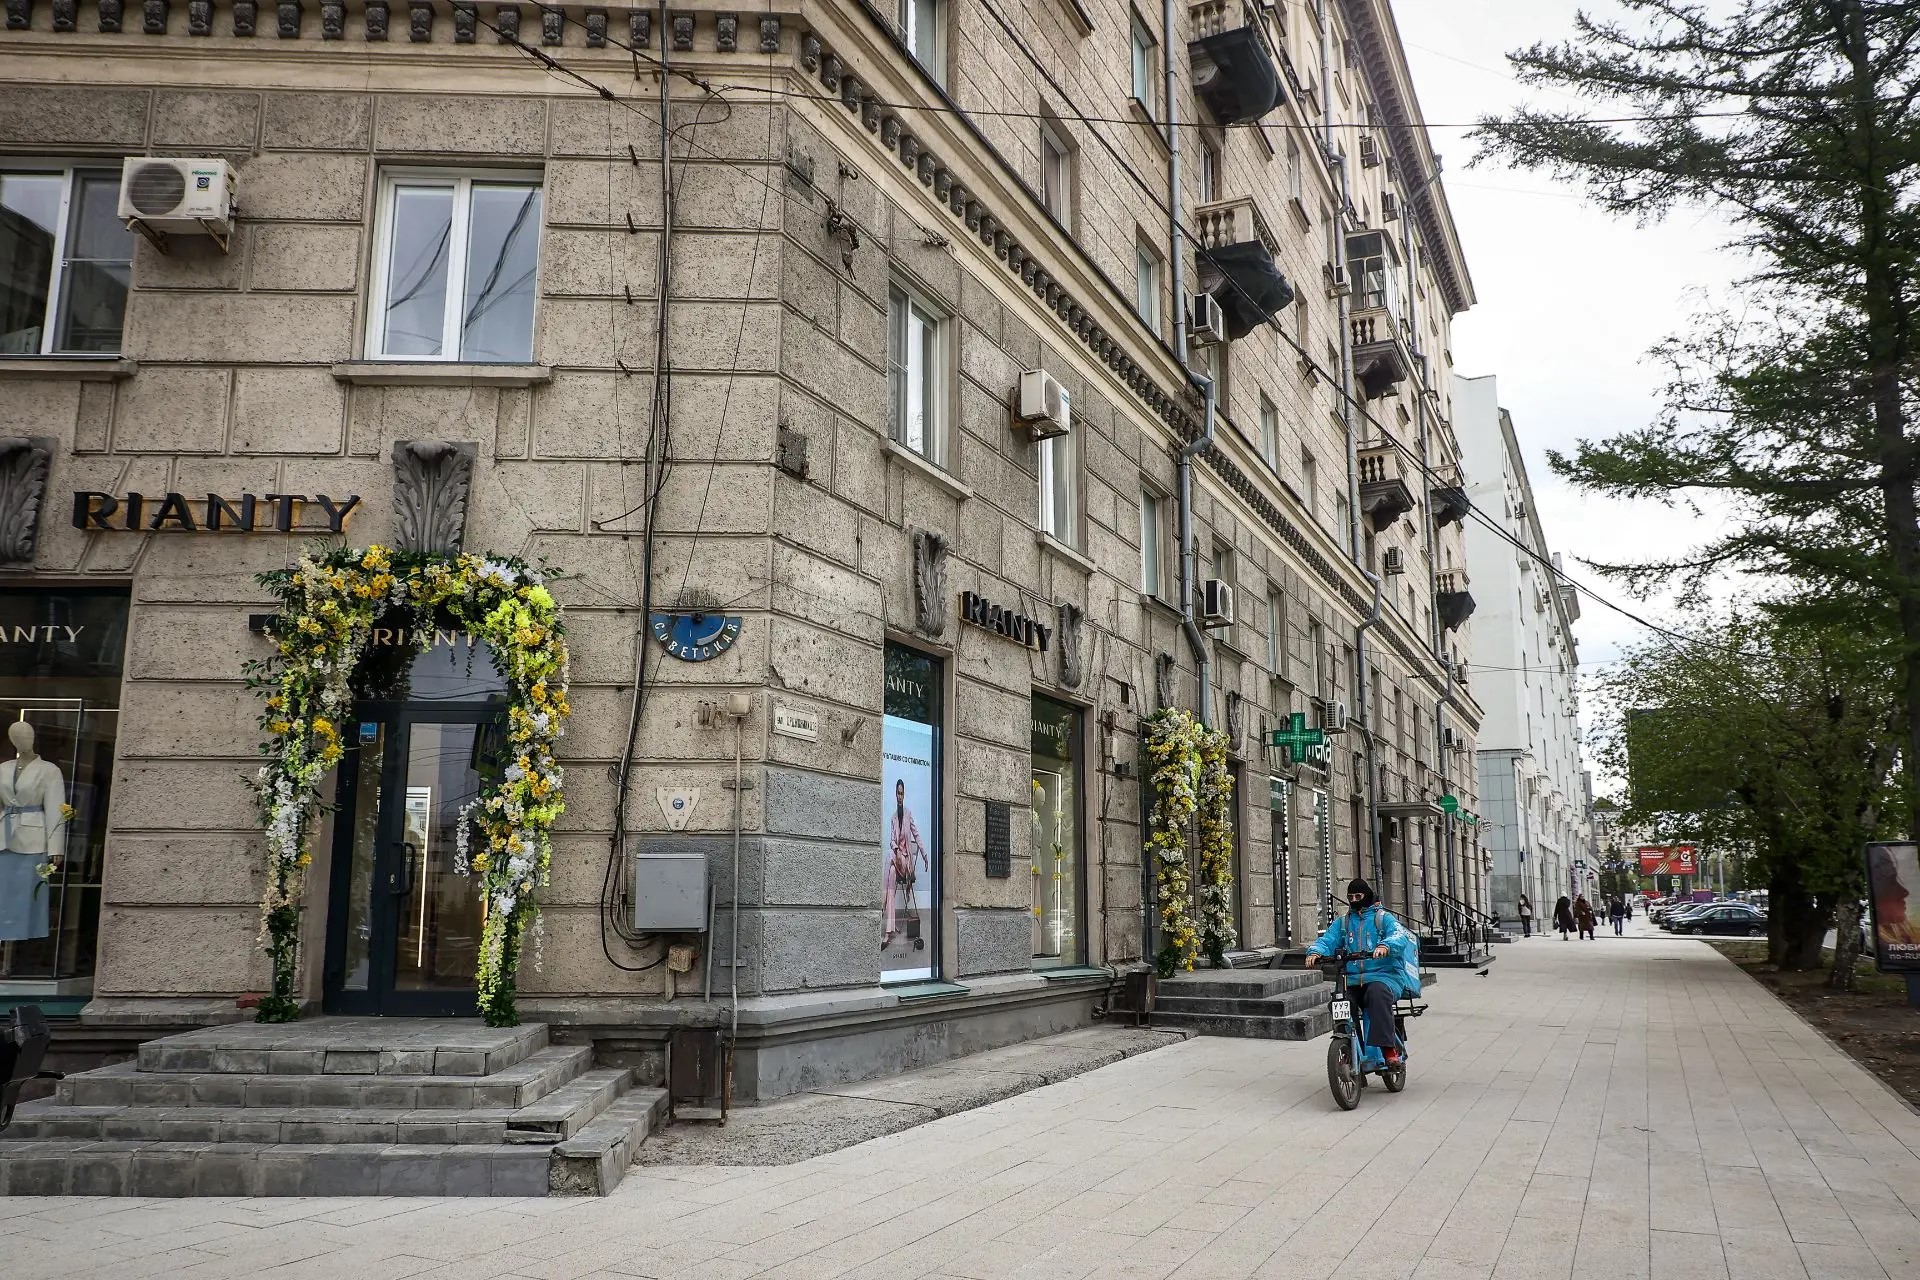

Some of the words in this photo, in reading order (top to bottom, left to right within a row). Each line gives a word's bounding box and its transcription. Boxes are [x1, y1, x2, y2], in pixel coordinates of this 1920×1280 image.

[72, 491, 361, 532] RIANTY
[373, 628, 476, 648] RIANT
[654, 622, 739, 659] СОВЕТСКАЯ
[962, 591, 1052, 651] RIANTY
